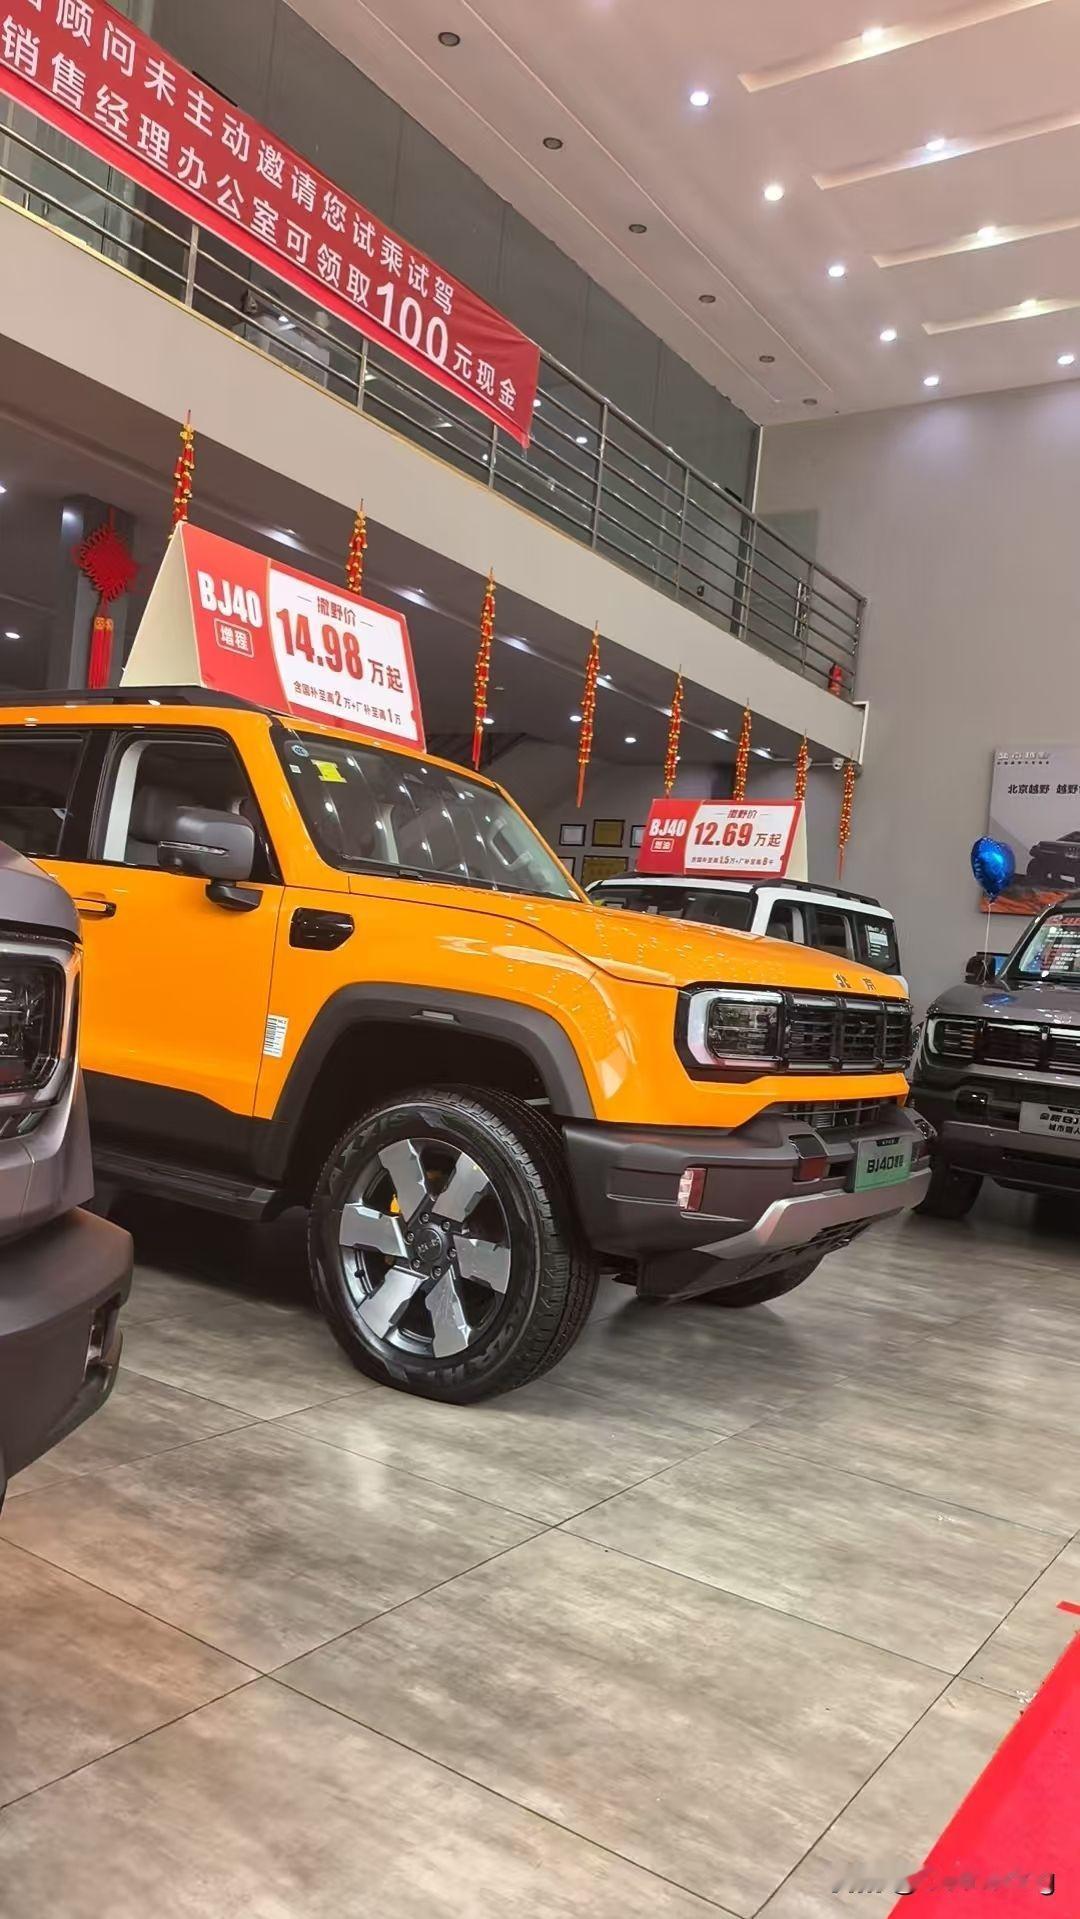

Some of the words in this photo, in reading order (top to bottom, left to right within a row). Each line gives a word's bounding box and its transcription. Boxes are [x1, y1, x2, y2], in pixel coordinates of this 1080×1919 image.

[27, 0, 454, 315] 顾问未主动邀请您试乘试驾
[2, 15, 516, 411] 销售经理办公室可领取100元现金
[197, 570, 263, 628] BJ40
[219, 625, 249, 650] 增程
[1056, 784, 1080, 794] 越野
[649, 819, 688, 837] BJ40
